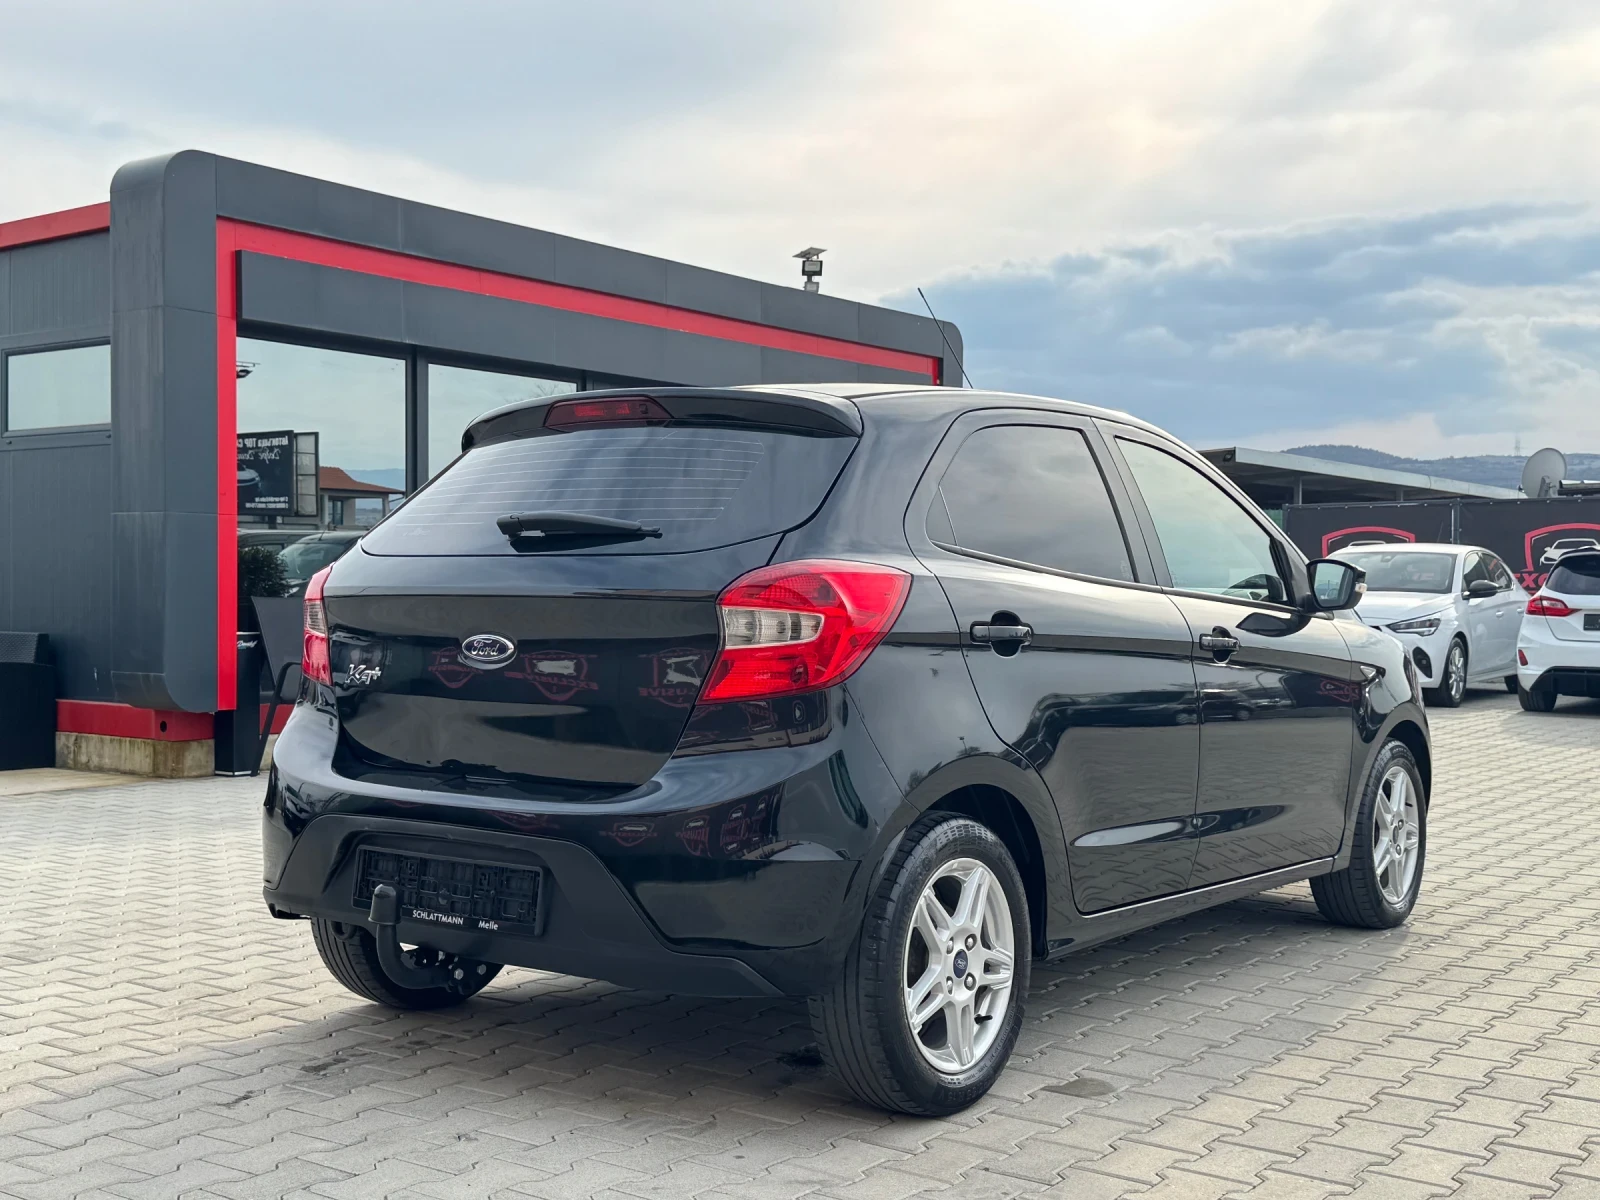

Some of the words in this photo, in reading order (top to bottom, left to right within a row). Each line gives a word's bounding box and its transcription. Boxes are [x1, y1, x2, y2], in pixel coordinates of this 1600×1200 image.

[471, 638, 500, 656] Ford
[412, 910, 464, 925] SCHLATTMANN
[478, 920, 498, 930] Melle
